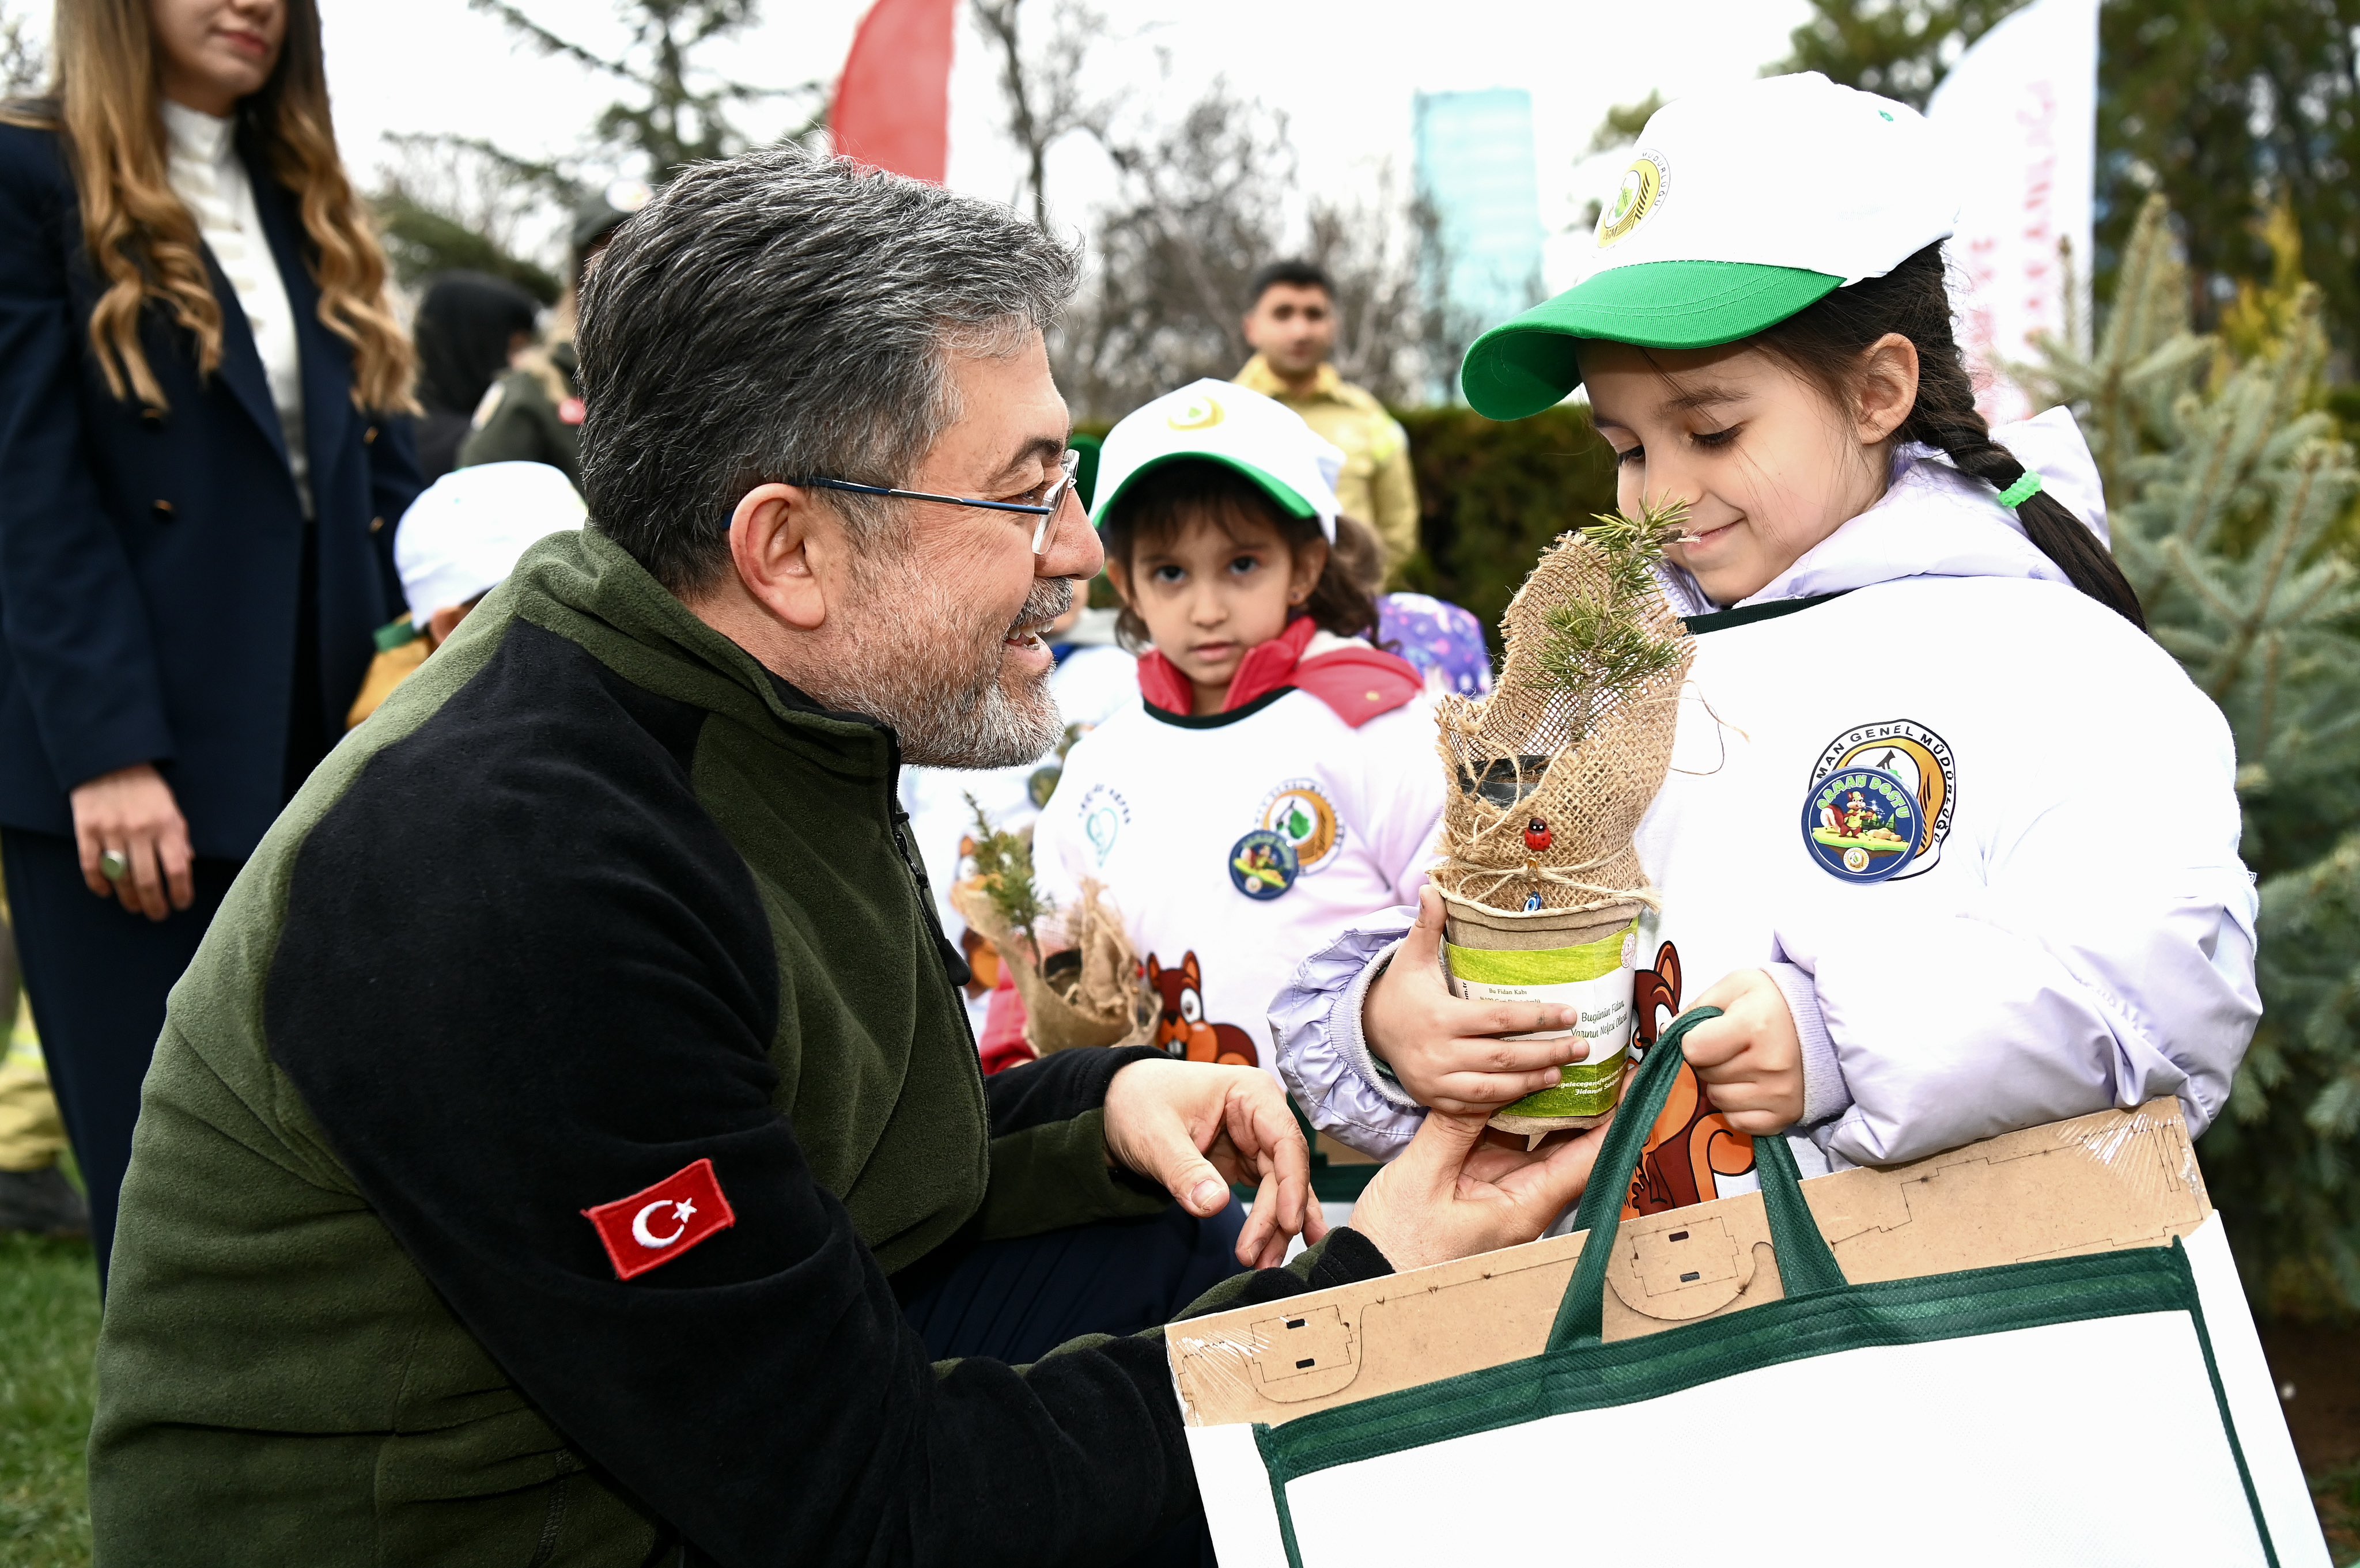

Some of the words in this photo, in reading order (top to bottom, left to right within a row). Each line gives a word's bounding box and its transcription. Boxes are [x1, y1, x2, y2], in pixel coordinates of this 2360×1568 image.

[1816, 743, 1845, 779] MAN
[1850, 725, 1914, 742] GENEL
[1817, 774, 1867, 810] ORMAN
[1869, 778, 1910, 819] DOSTU
[1582, 1008, 1610, 1024] Bugünün
[1600, 1020, 1615, 1035] Nefesi
